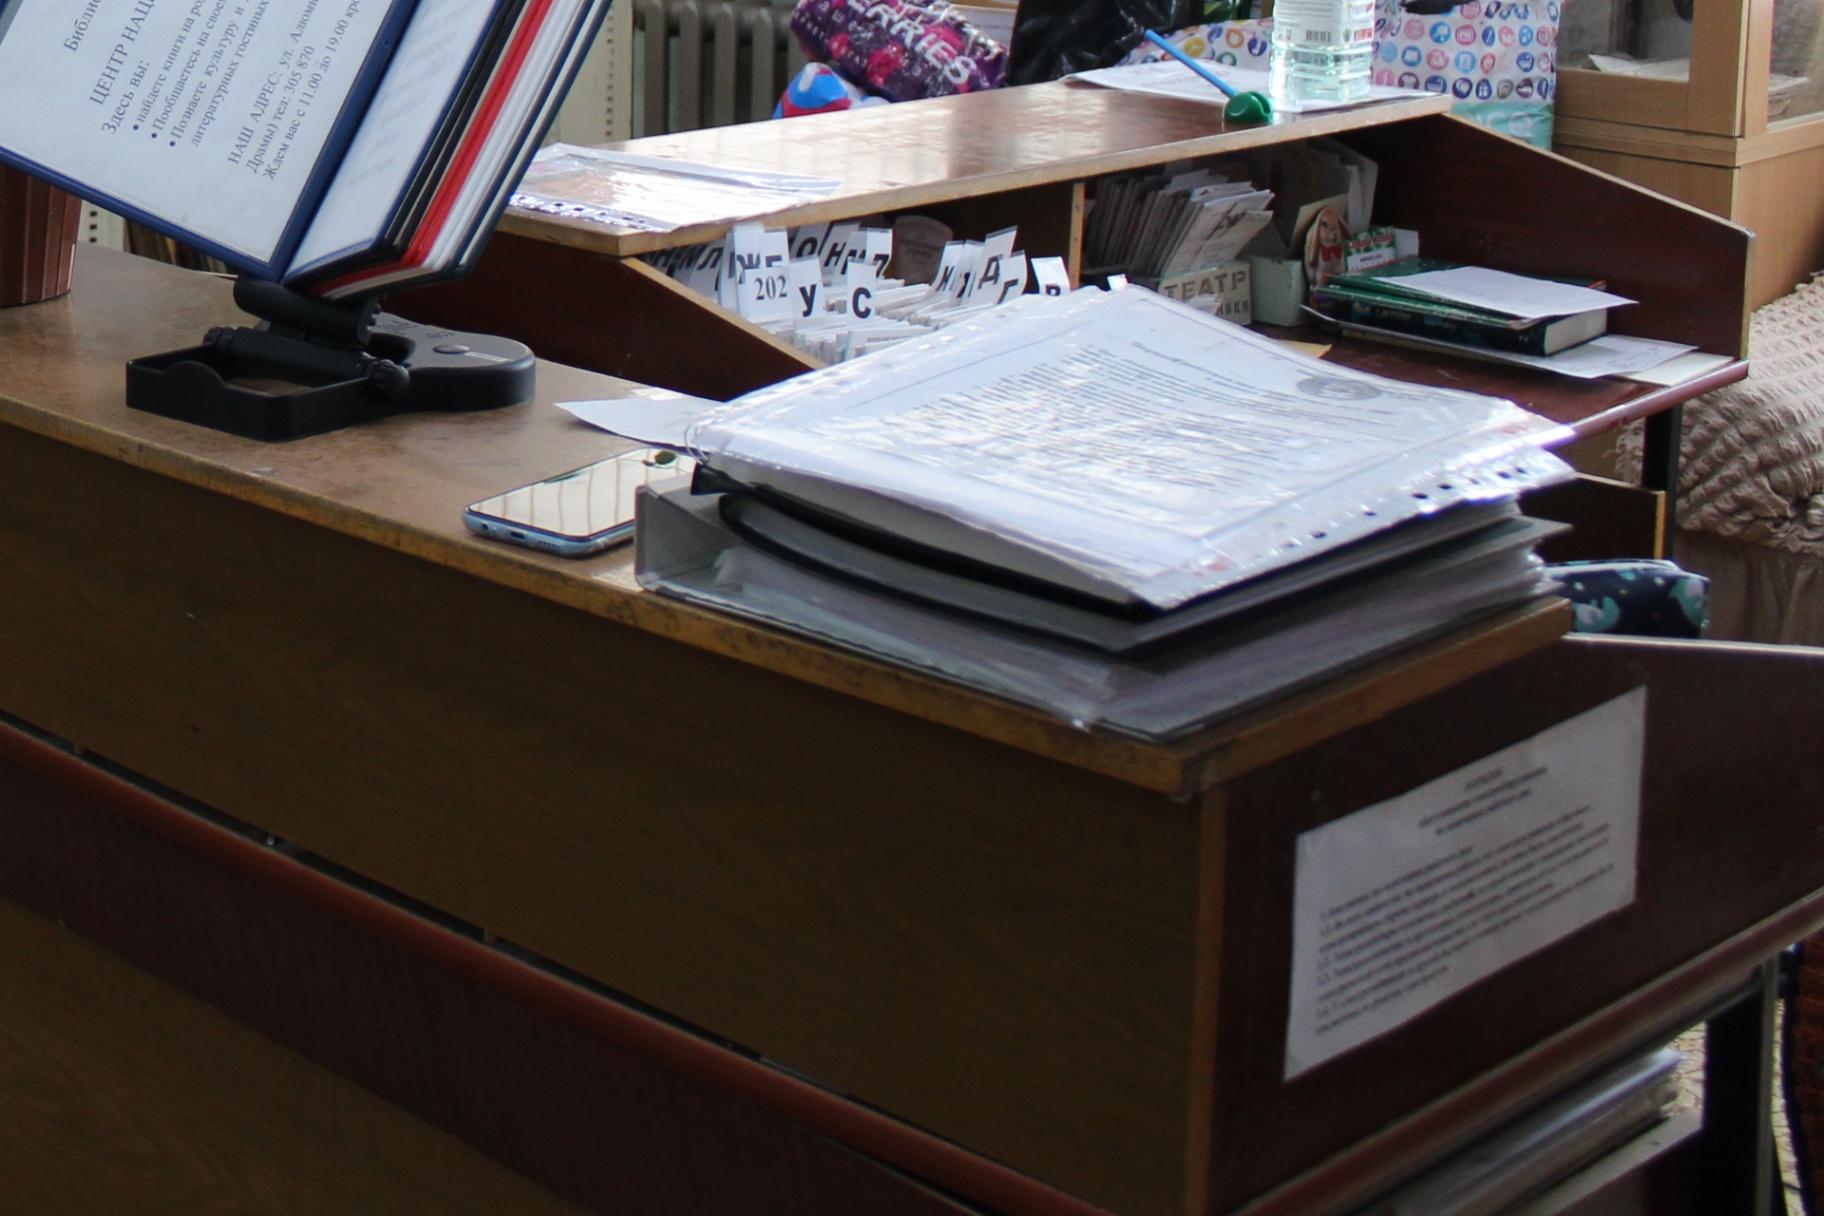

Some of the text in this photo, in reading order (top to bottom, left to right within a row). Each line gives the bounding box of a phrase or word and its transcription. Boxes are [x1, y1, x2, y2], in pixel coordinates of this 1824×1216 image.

[88, 43, 127, 104] ЦЕНТР
[203, 20, 238, 76] культуру
[283, 70, 301, 93] 305
[296, 45, 314, 68] 870
[136, 73, 166, 122] найдете
[161, 34, 186, 71] книги
[191, 60, 239, 147] литературных
[262, 142, 289, 180] Ждем
[285, 119, 300, 140] вас
[299, 71, 323, 106] 11.00
[325, 19, 348, 51] 19.00
[100, 91, 134, 134] Здесь
[227, 126, 254, 164] НАШ
[249, 71, 281, 122] АДРЕС:
[278, 49, 293, 68] ул.
[799, 283, 817, 317] У
[852, 286, 872, 319] С
[1164, 272, 1248, 302] ТЕАТР
